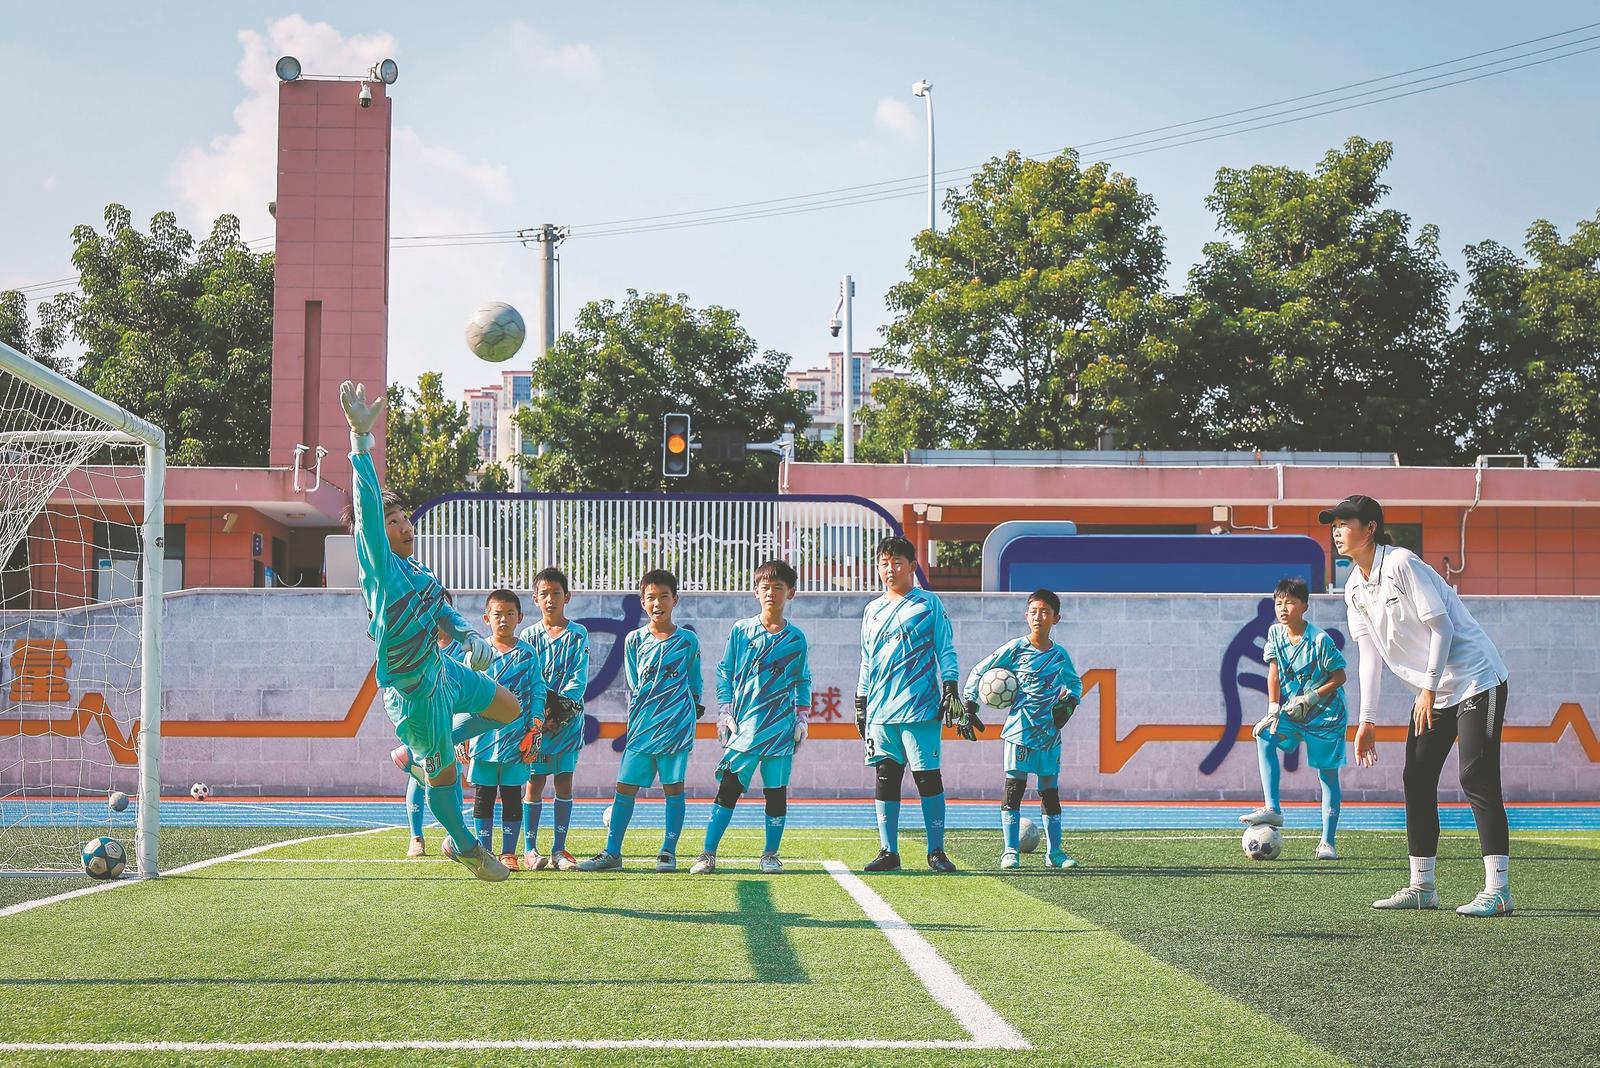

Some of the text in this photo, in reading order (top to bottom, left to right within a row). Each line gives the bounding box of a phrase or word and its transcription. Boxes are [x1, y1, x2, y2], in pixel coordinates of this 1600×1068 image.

[9, 639, 72, 702] 量
[809, 686, 842, 721] 球
[864, 737, 876, 758] 3
